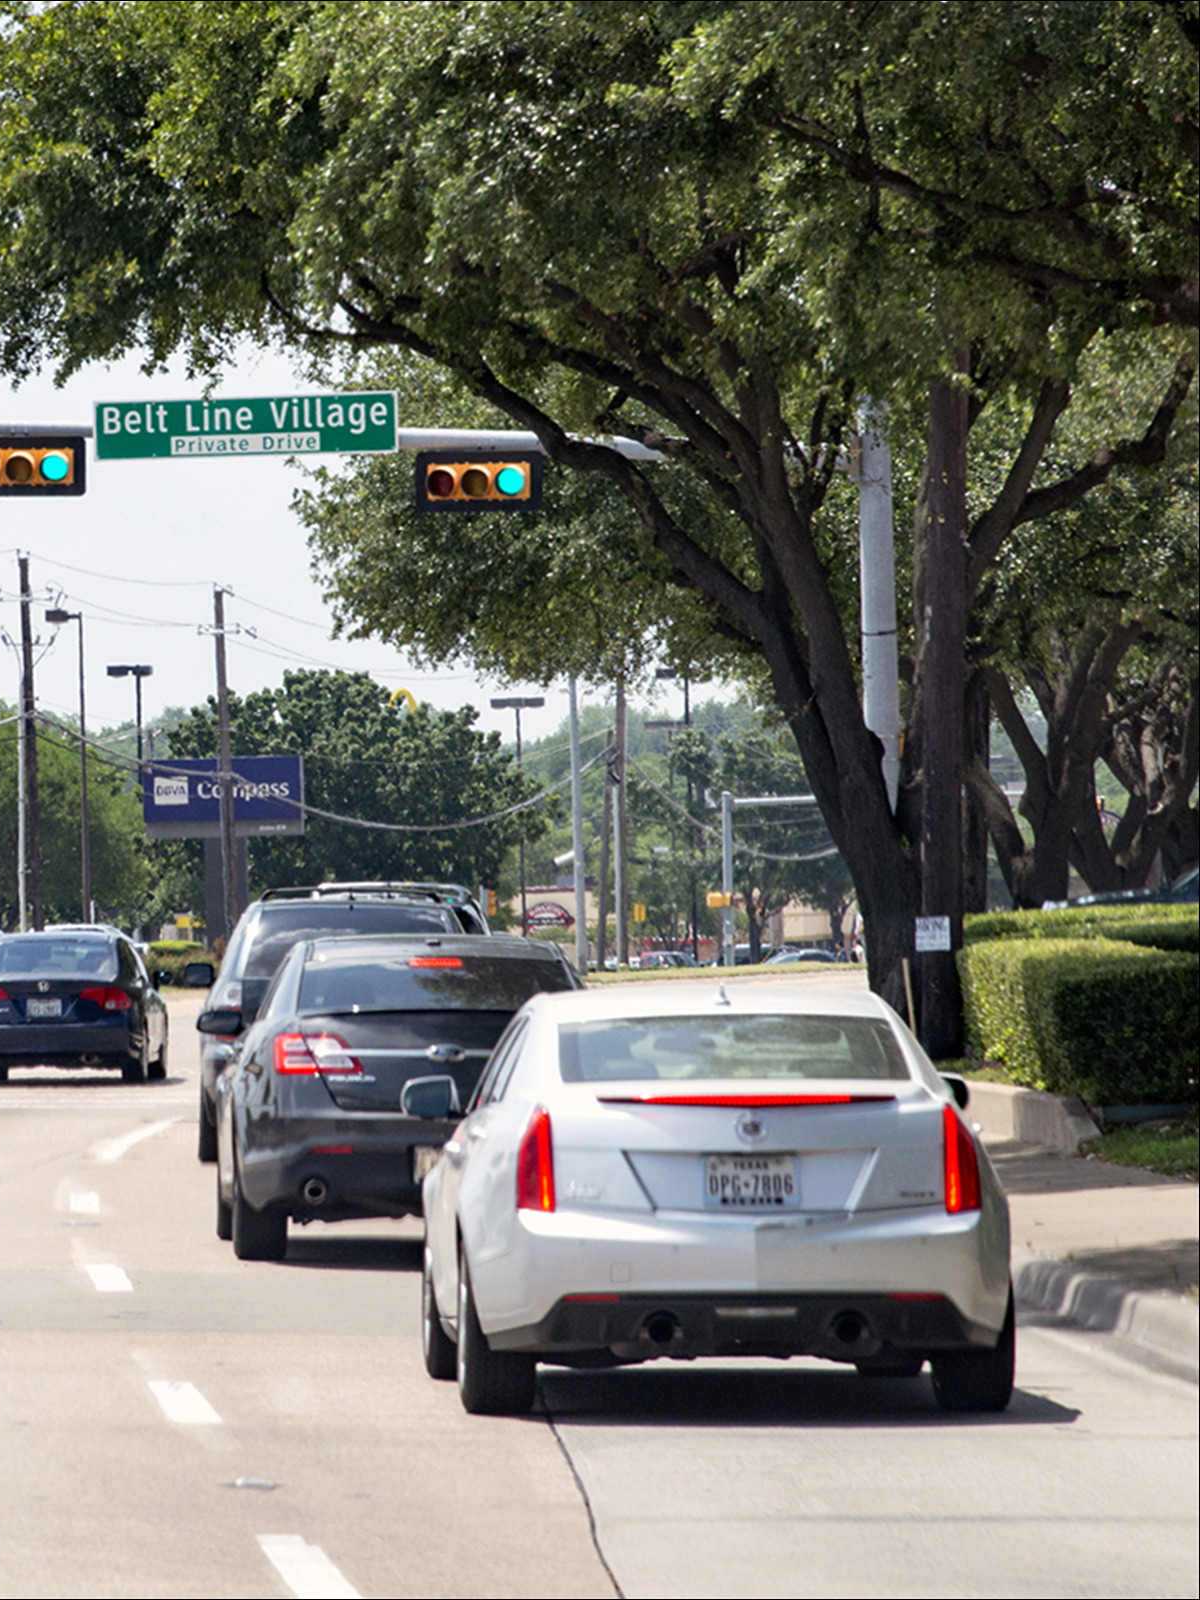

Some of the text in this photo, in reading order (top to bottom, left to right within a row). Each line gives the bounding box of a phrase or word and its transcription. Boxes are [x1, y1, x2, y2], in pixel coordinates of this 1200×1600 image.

[102, 397, 388, 435] Belt Line Village
[174, 434, 317, 453] Private Drive
[156, 785, 187, 797] BBVA
[732, 1160, 770, 1170] TEXAS
